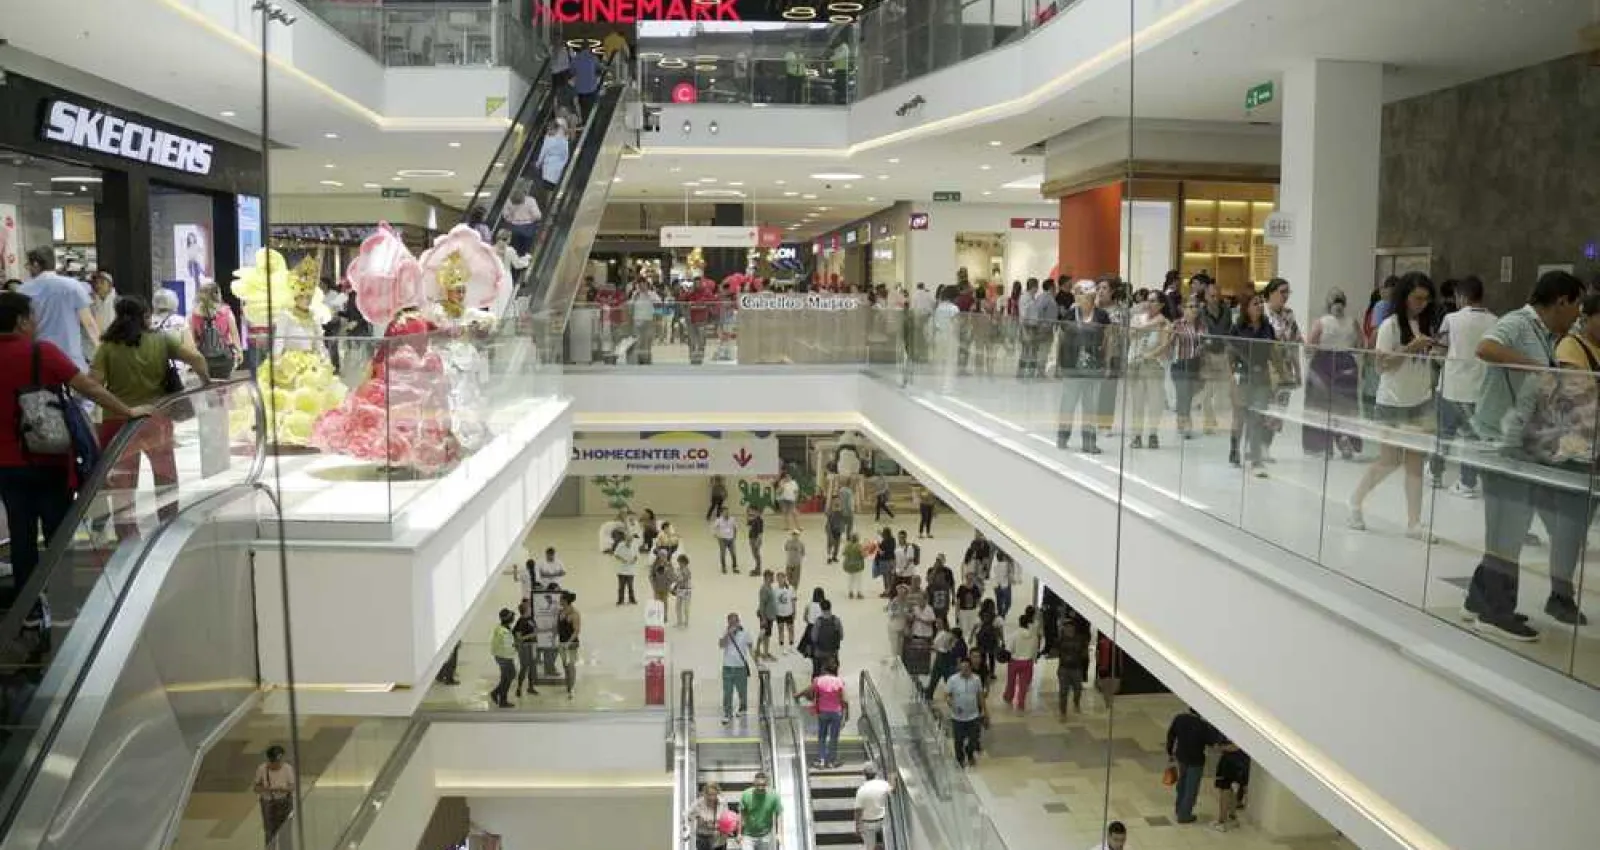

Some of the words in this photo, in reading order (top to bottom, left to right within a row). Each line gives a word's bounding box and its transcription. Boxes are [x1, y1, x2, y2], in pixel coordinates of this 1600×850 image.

[557, 0, 742, 23] CINEMARK
[47, 100, 214, 175] SKECHERS
[582, 448, 709, 460] HOMECENTER.CO
